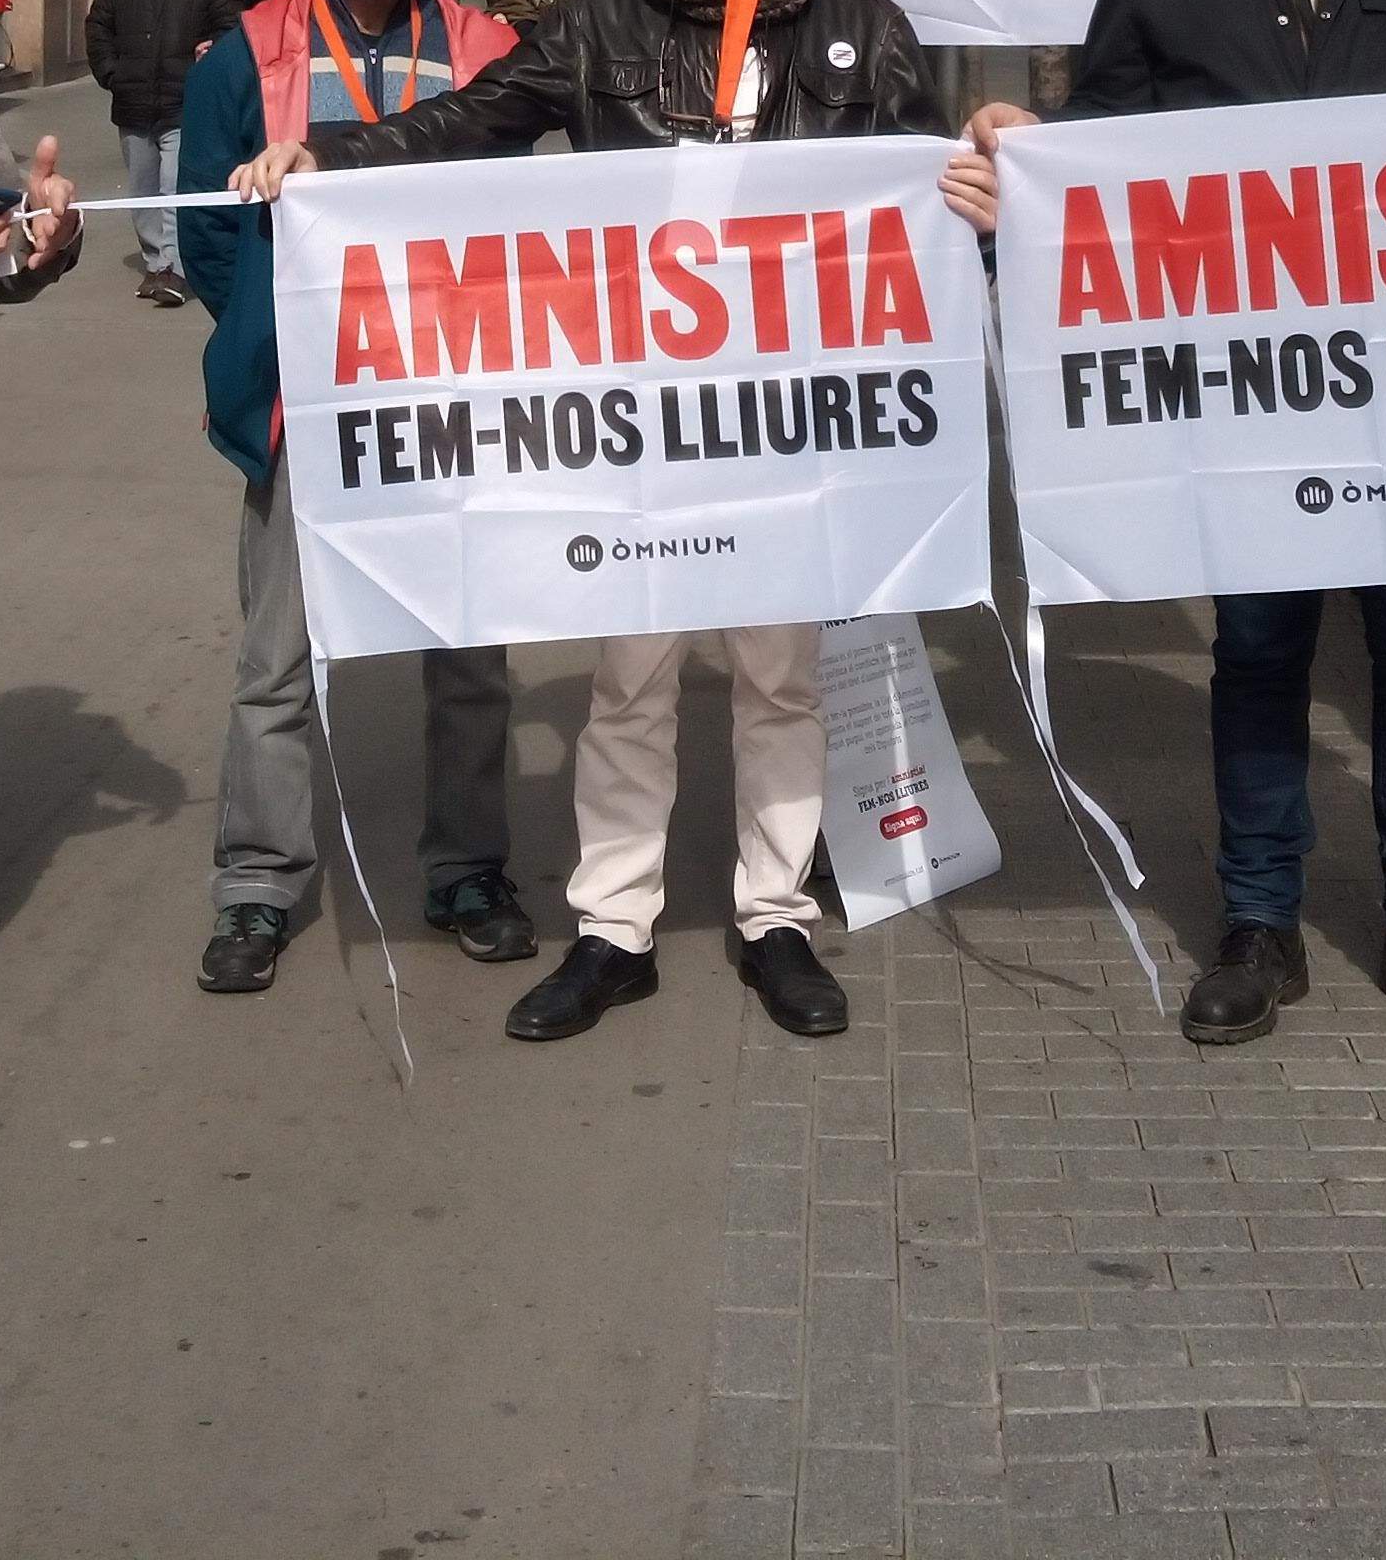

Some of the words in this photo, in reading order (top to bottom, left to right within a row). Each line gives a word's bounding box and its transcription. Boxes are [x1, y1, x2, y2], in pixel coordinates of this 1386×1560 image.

[333, 205, 934, 386] AMNISTIA
[335, 390, 645, 490] FEM-NOS
[660, 368, 940, 463] LLIURES
[1059, 329, 1375, 429] FEM-NOS
[611, 535, 736, 561] ÒMNIUM
[857, 790, 896, 814] FEM-NOS
[896, 778, 930, 800] LLIURES
